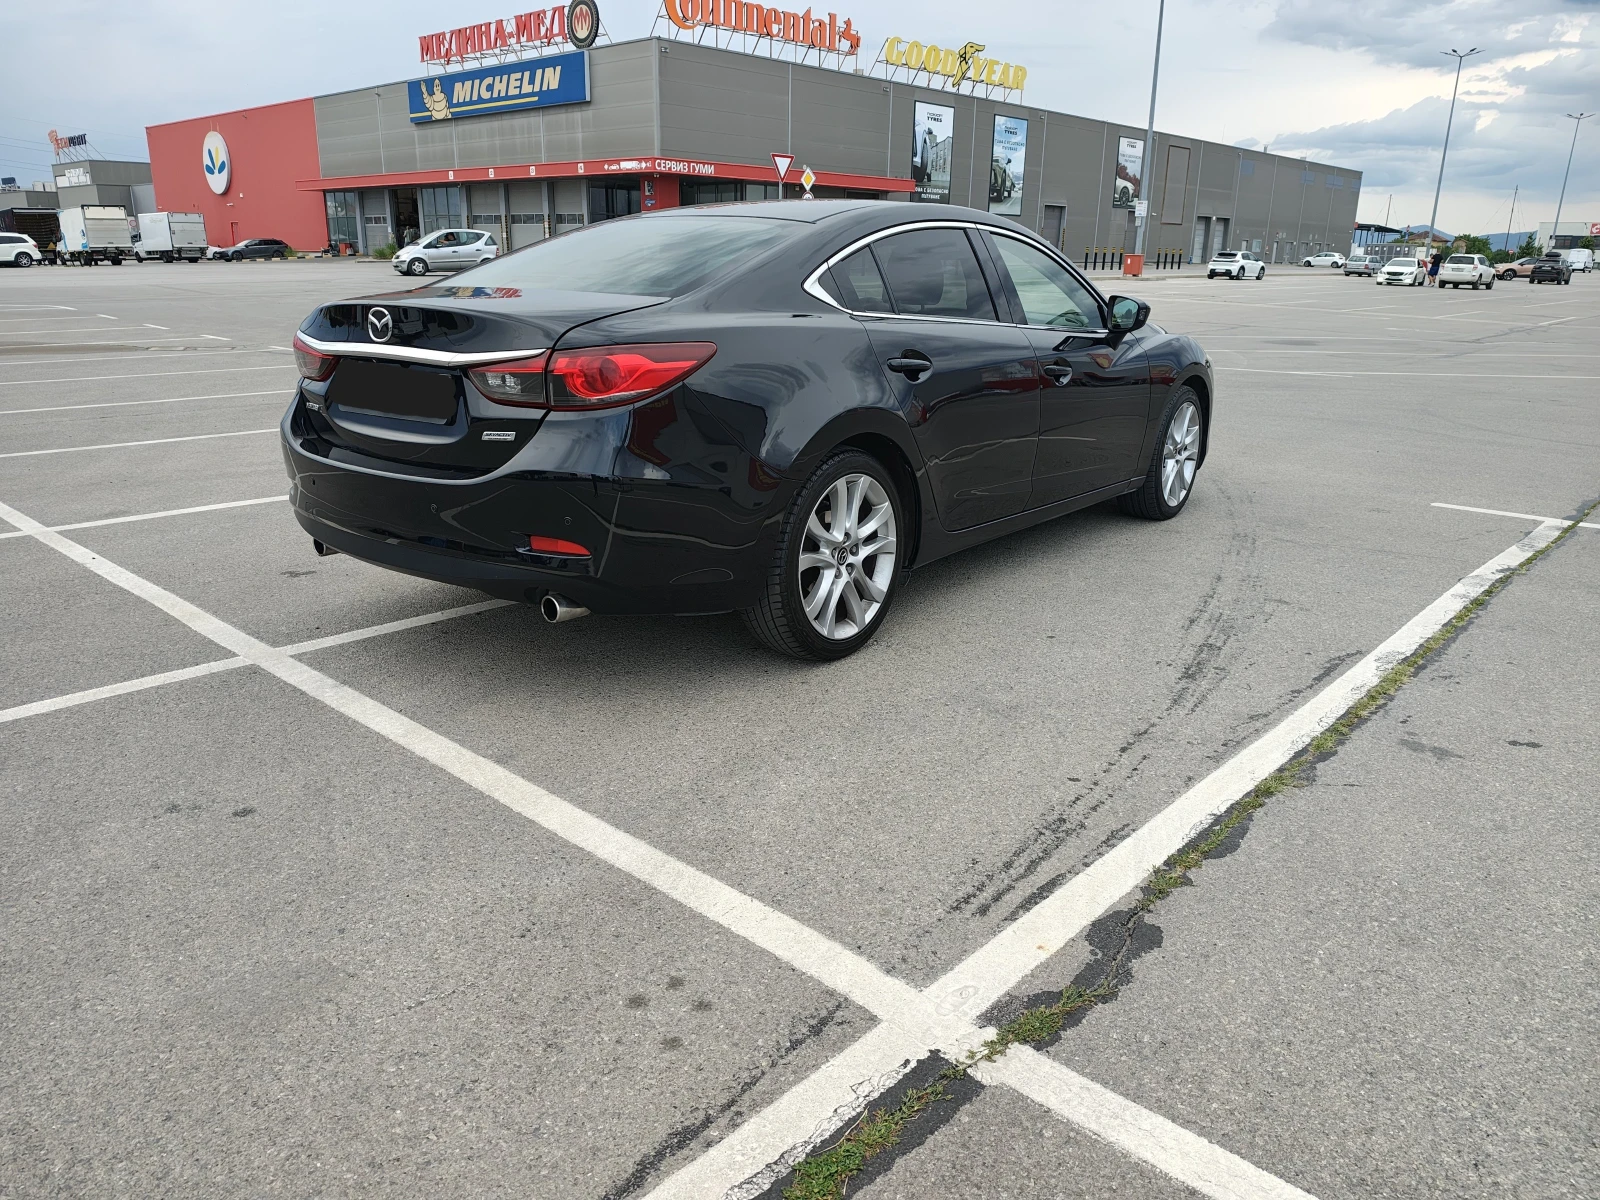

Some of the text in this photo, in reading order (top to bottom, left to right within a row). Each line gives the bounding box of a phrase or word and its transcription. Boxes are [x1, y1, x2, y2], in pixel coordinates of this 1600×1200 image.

[418, 5, 568, 65] МЕДИНА-МЕД
[452, 65, 562, 104] MICHELIN
[655, 159, 715, 175] СЕРВИЗ ГУМИ
